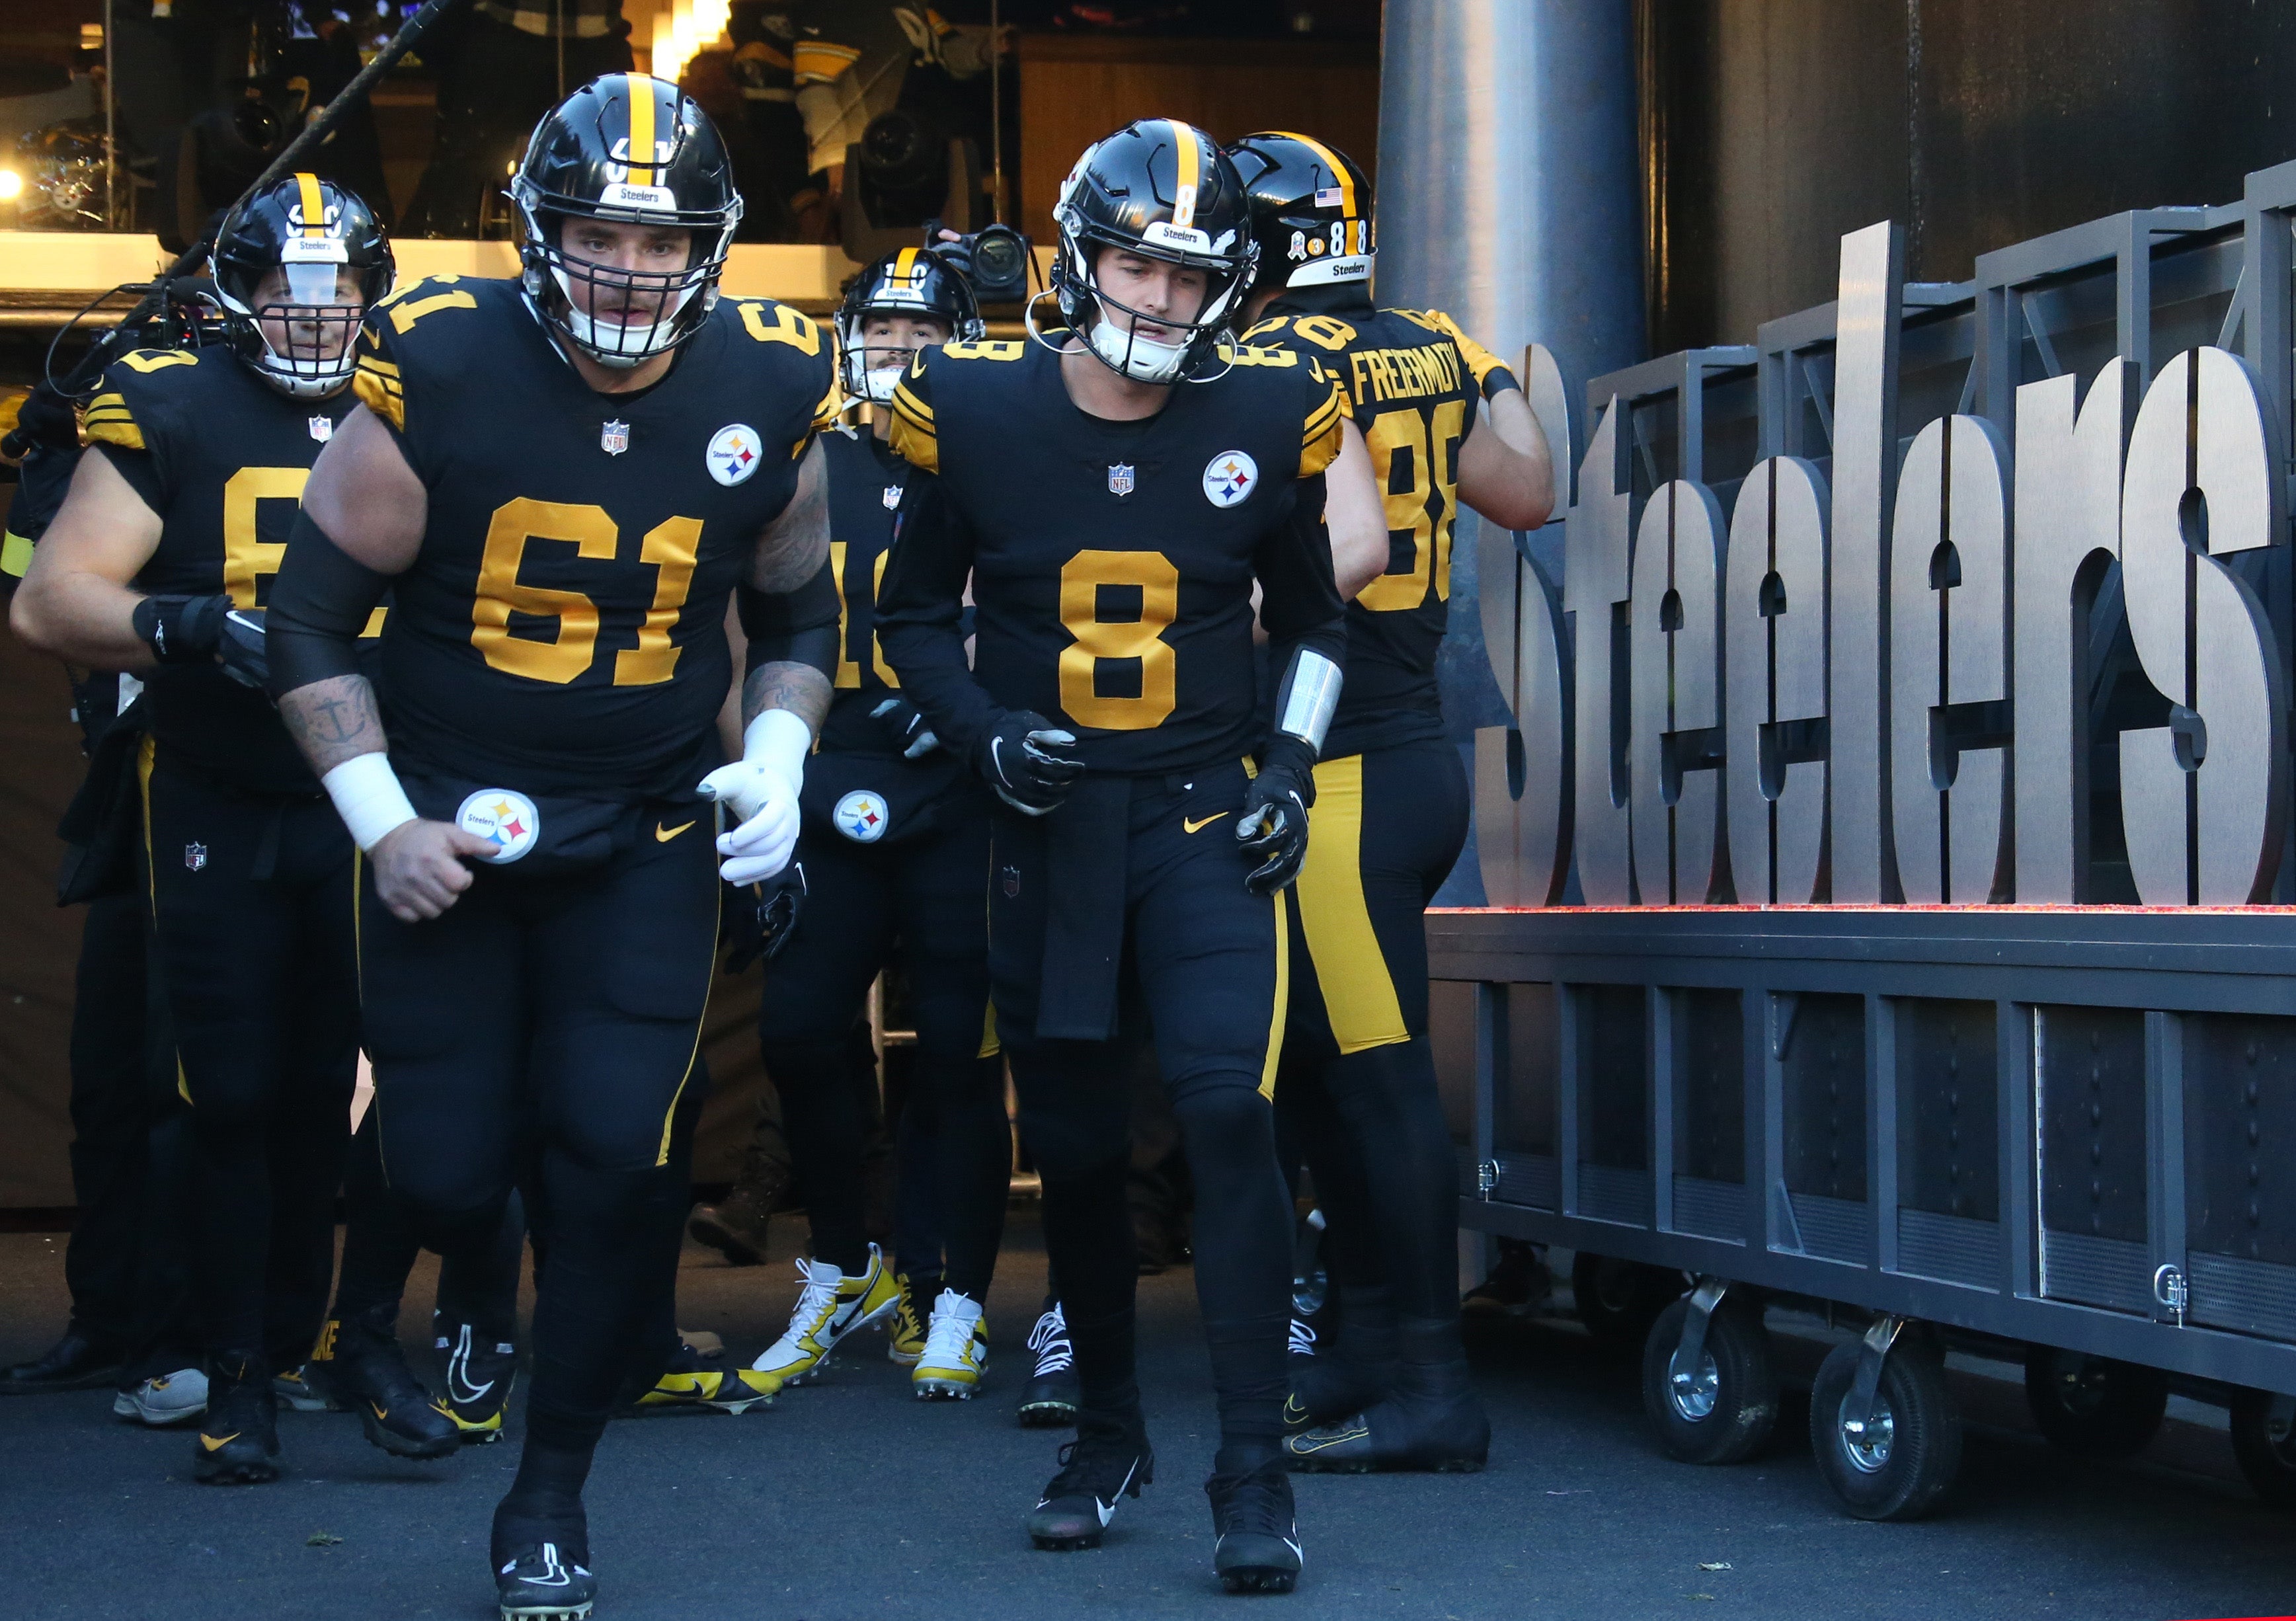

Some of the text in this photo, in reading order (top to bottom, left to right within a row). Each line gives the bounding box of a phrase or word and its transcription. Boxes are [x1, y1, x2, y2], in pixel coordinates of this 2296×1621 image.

[605, 138, 673, 186] 61
[620, 188, 659, 203] Steelers
[1173, 184, 1197, 226] 8
[1163, 227, 1198, 243] Steelers
[1329, 219, 1366, 257] 88
[299, 241, 331, 251] Steelers
[1312, 239, 1321, 254] 3
[883, 262, 928, 290] 10
[1332, 262, 1365, 276] Steelers
[886, 289, 912, 298] Steelers
[719, 294, 820, 357] 6
[605, 435, 625, 450] NFL
[713, 450, 734, 459] Steelers
[1112, 477, 1131, 491] NFL
[1208, 474, 1229, 483] Steelers
[1474, 219, 2279, 906] Steelers
[471, 496, 704, 686] 61
[1059, 549, 1179, 731] 8
[467, 814, 495, 827] Steelers
